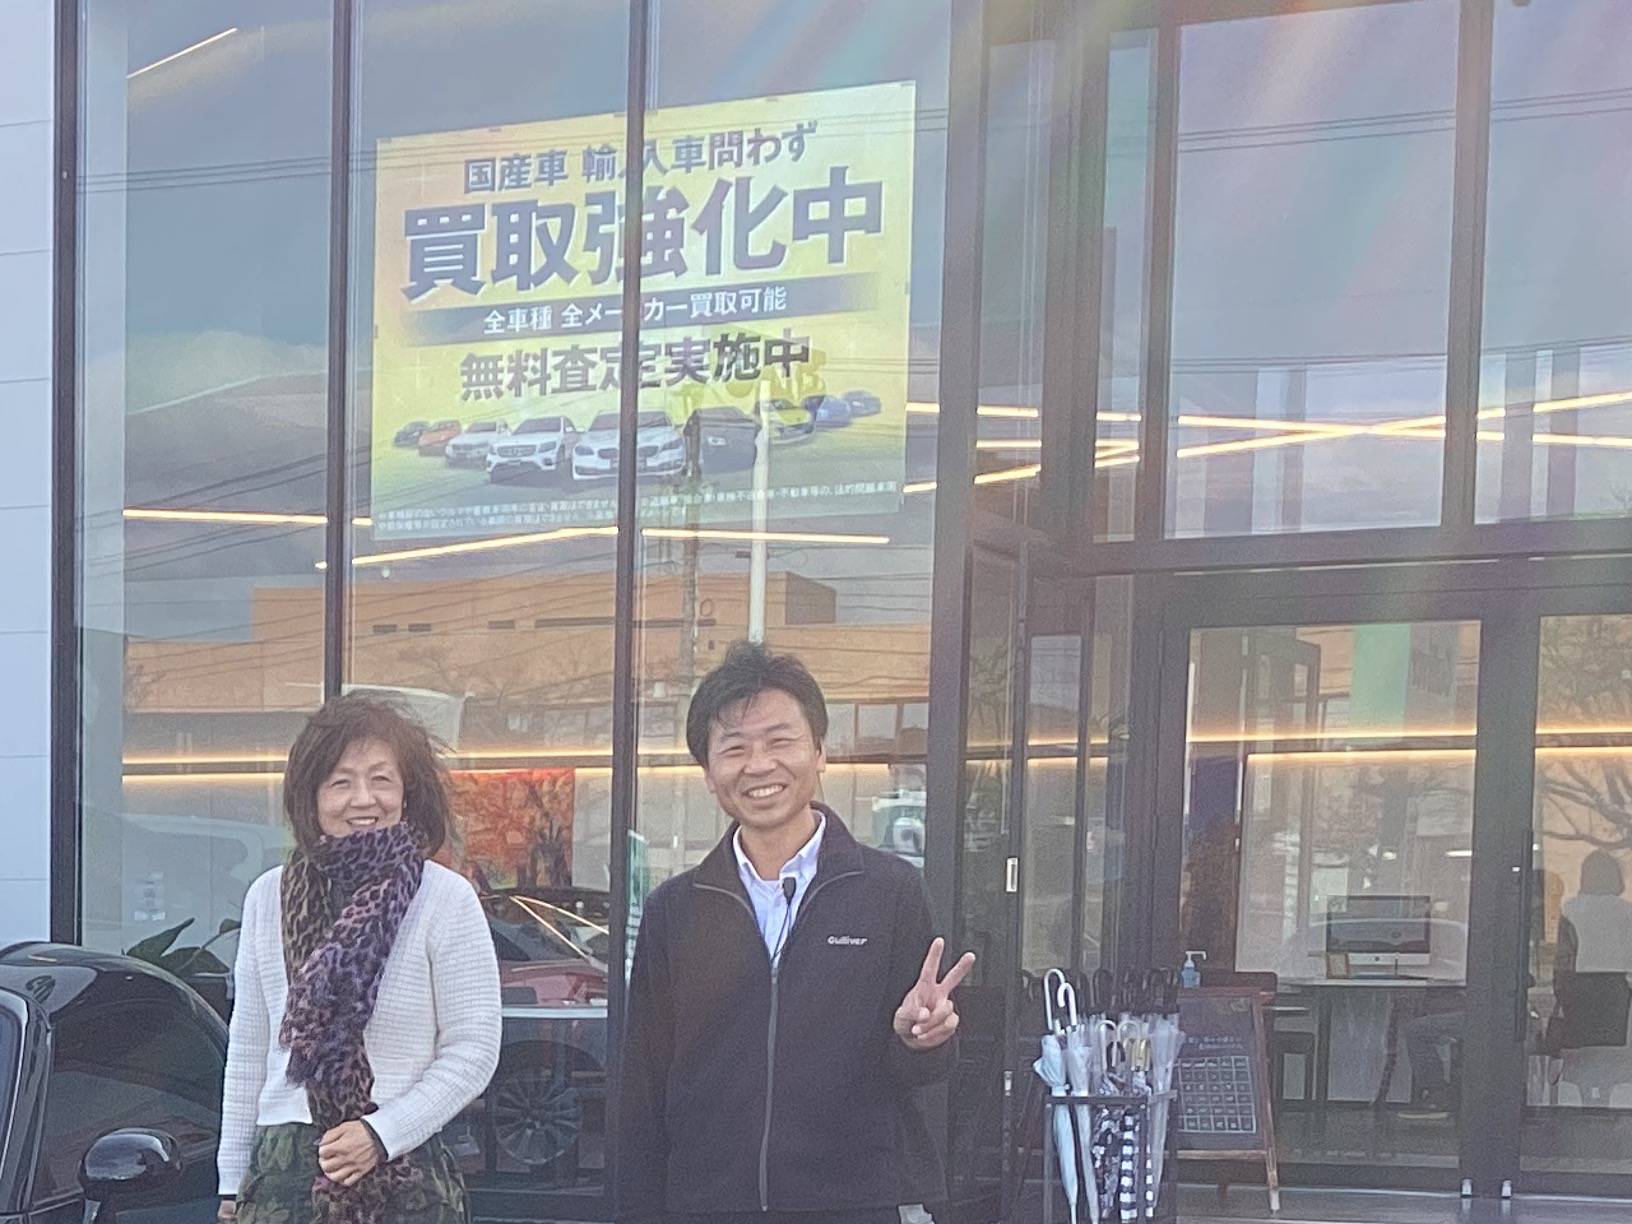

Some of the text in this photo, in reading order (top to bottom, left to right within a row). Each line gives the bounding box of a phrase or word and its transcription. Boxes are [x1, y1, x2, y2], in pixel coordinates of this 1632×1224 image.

[464, 120, 818, 195] 国産車 輸入車問わず
[400, 165, 883, 301] 買取強化中
[482, 285, 788, 336] 全車種 全メーカー買取可能
[460, 327, 811, 402] 無料査定実施中
